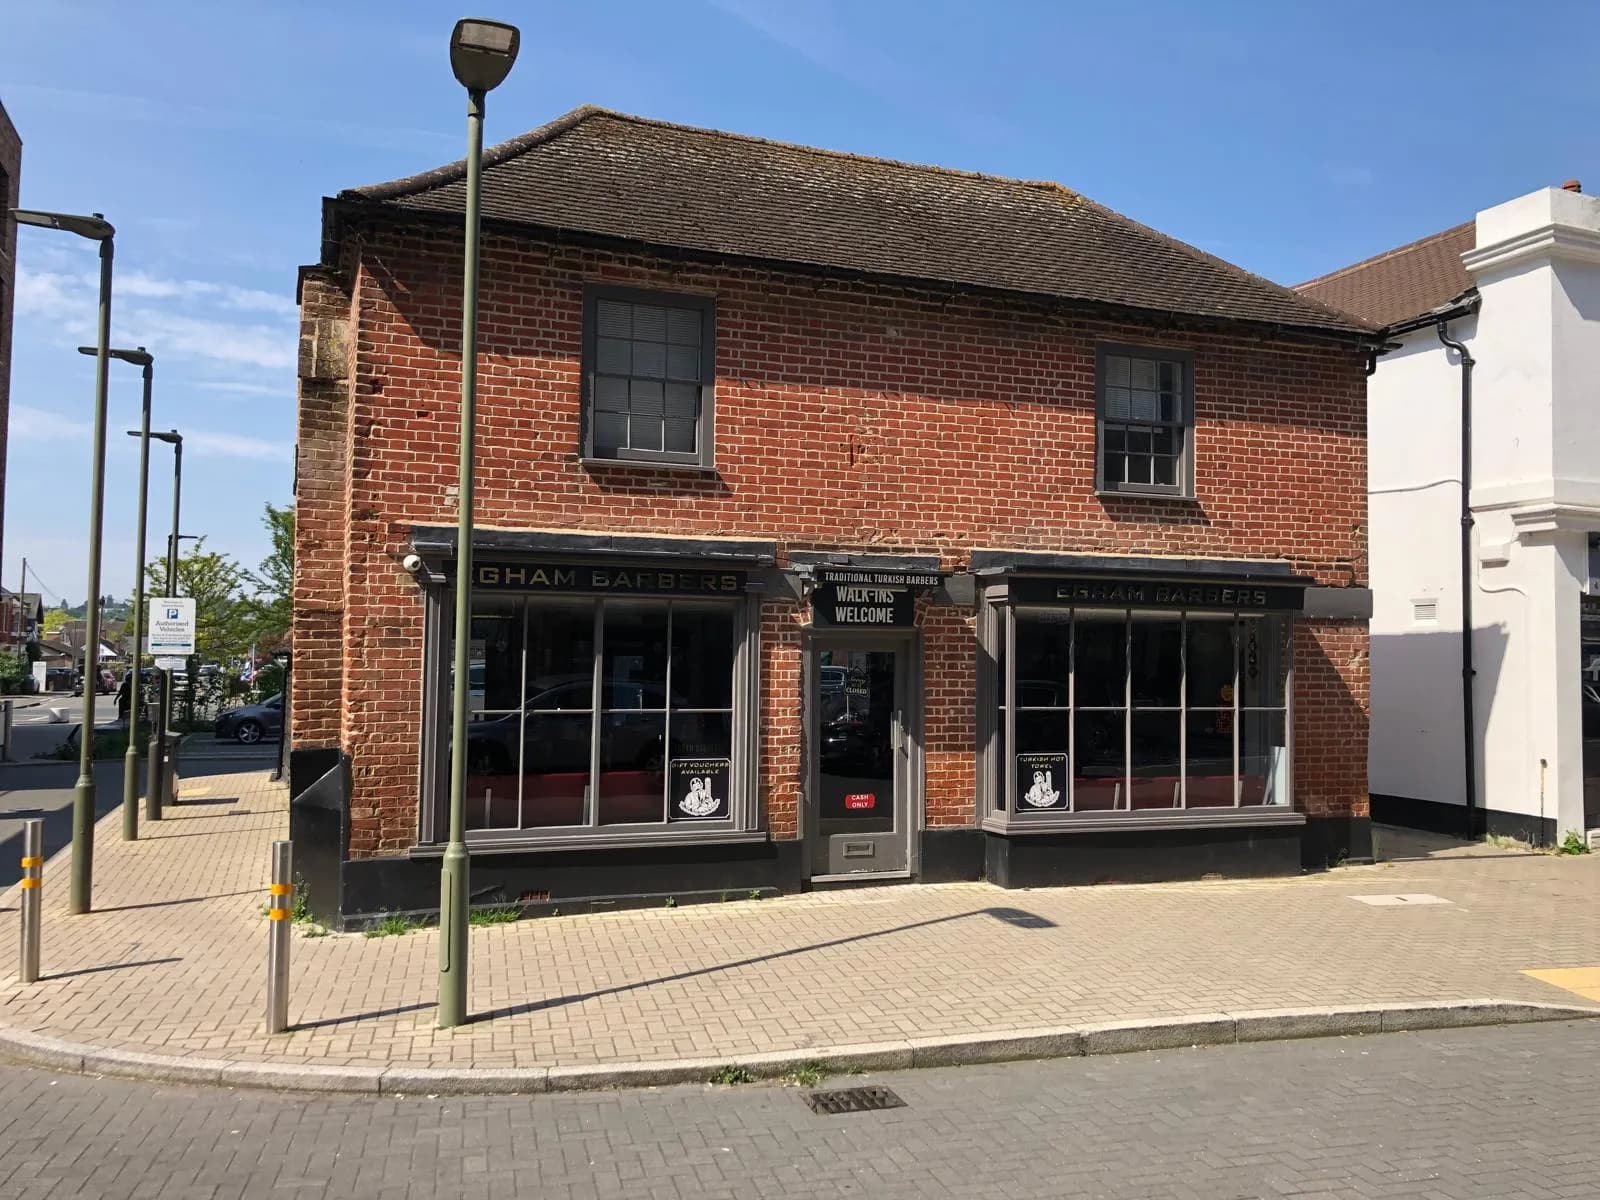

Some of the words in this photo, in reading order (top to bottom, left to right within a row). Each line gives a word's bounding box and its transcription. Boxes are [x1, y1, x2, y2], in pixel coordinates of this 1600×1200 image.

[471, 567, 575, 586] GHAM
[592, 570, 738, 591] BARBERS
[825, 572, 873, 583] TRADITIONAL
[874, 574, 905, 584] TURKISH
[906, 576, 939, 586] BARBERS
[836, 585, 894, 603] WALK-INS
[1056, 584, 1145, 601] EGHAM
[1156, 588, 1267, 605] BARBERS
[835, 606, 894, 623] WELCOME
